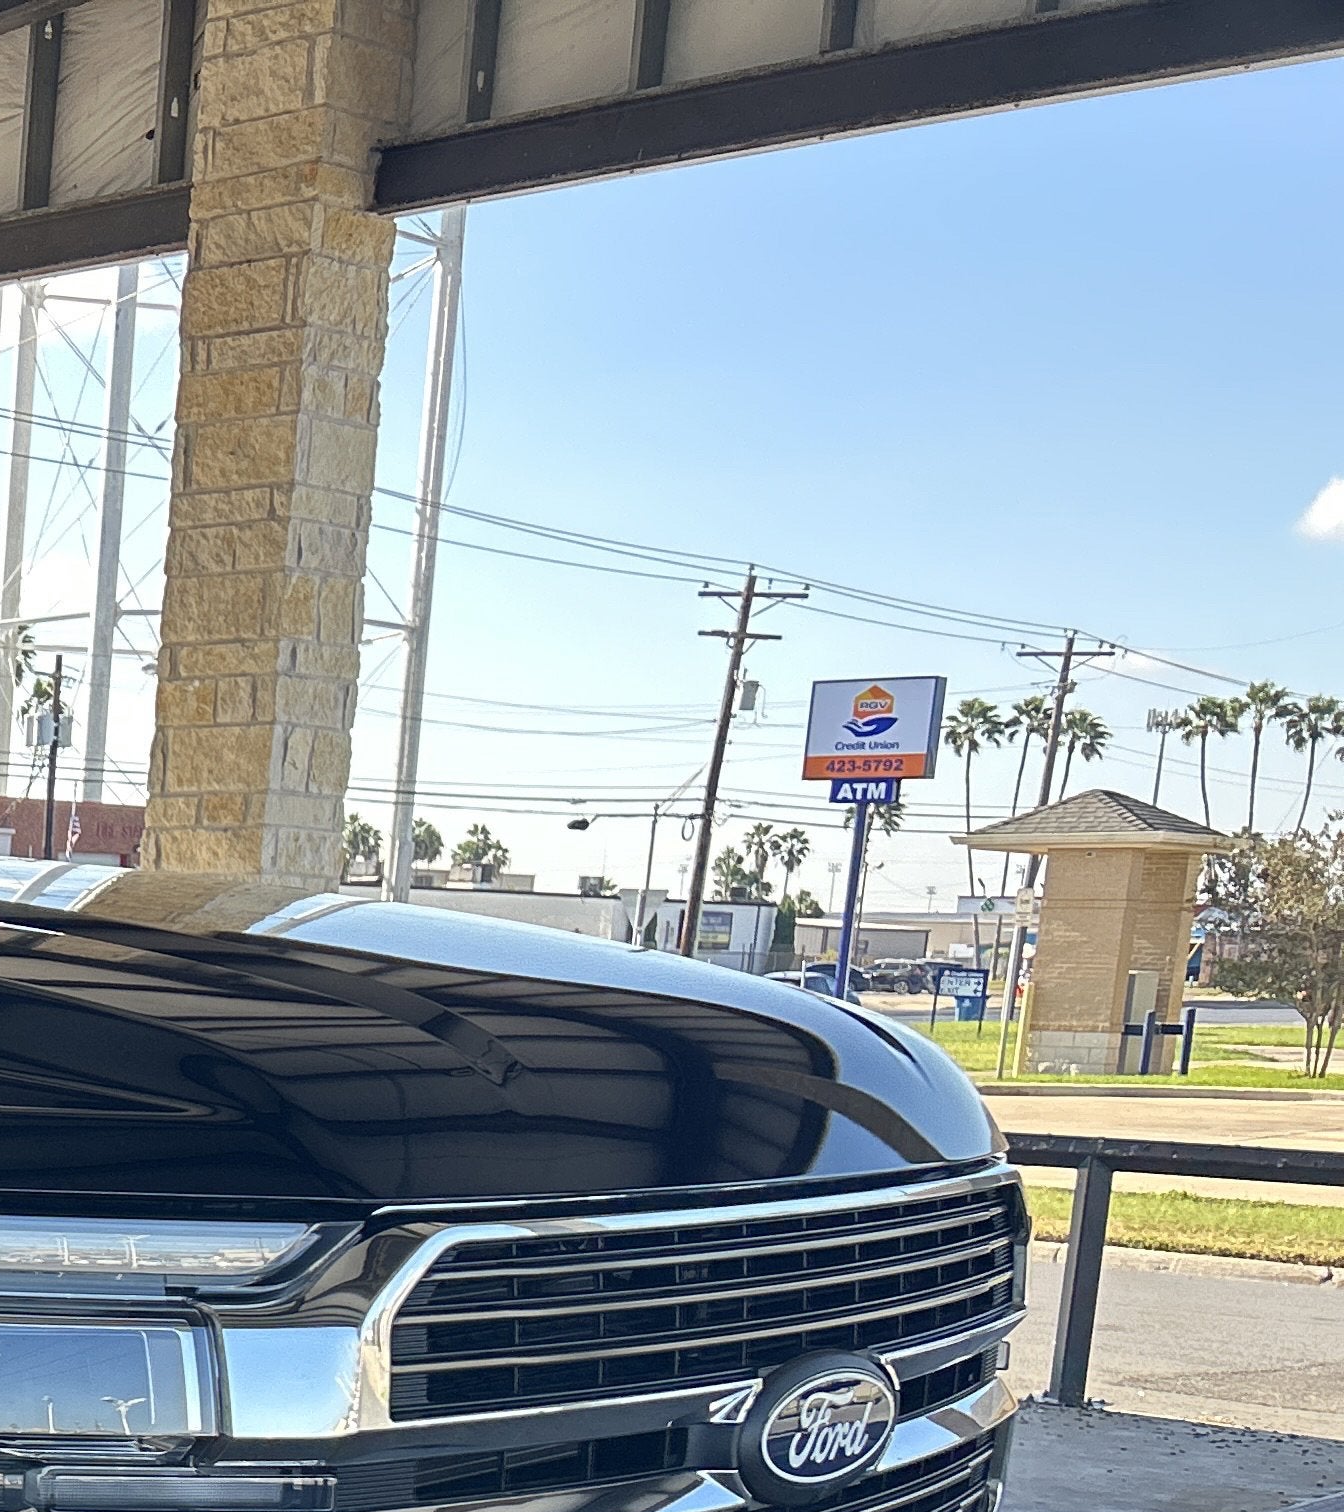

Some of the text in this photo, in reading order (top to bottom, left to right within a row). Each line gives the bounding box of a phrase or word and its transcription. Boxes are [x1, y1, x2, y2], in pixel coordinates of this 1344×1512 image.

[834, 740, 900, 751] Credit Union
[826, 758, 904, 773] 423-5792
[836, 782, 887, 800] ATM
[788, 1387, 874, 1469] Ford
